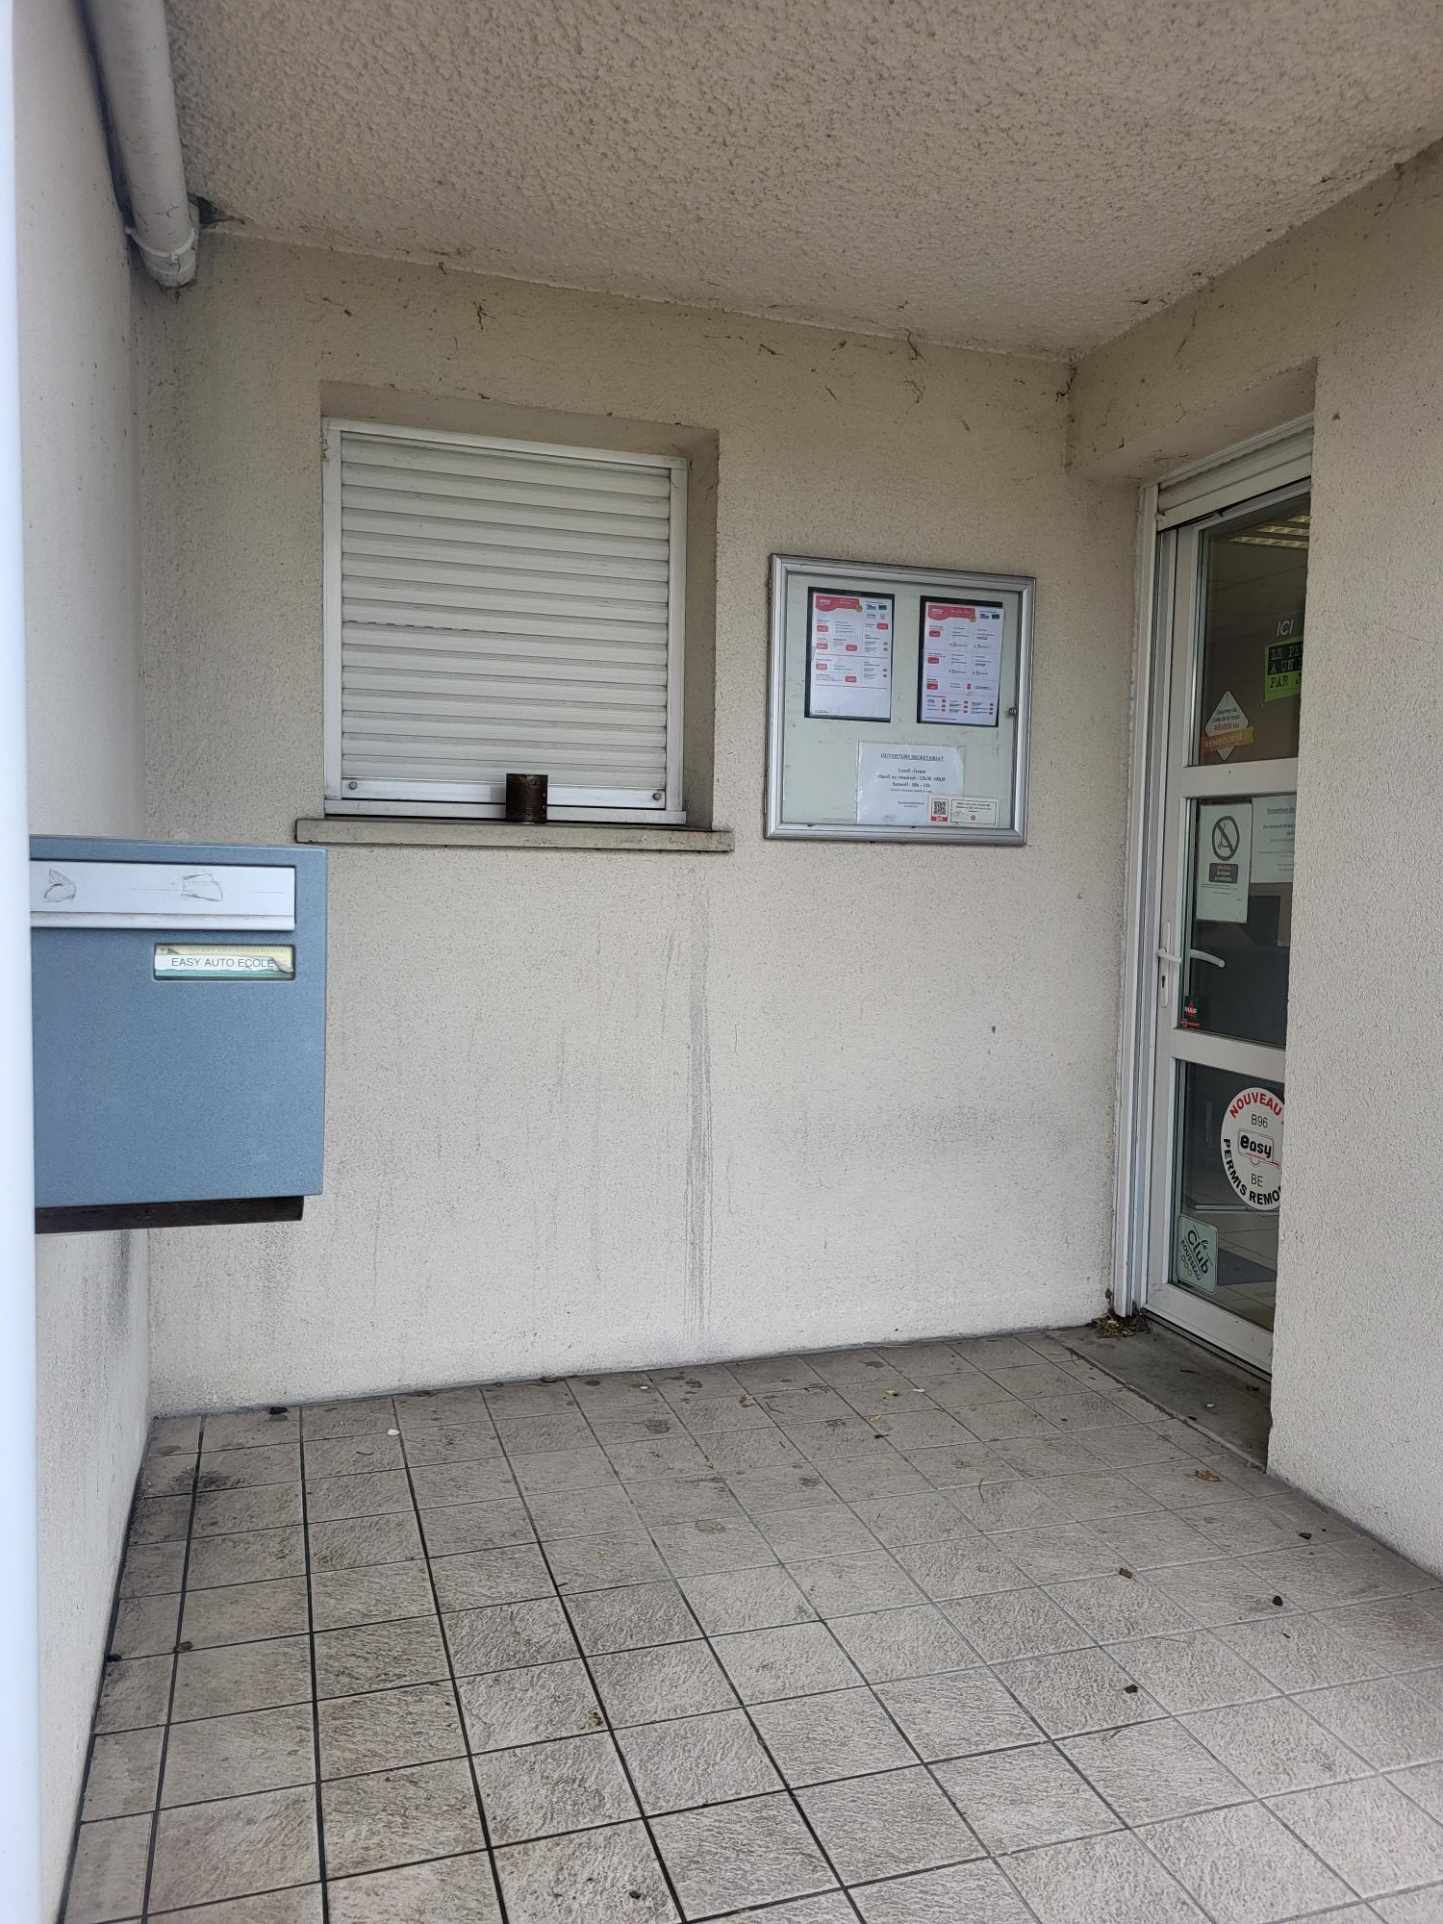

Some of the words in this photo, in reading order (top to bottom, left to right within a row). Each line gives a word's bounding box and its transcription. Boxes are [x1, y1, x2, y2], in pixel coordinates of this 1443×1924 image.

[1276, 619, 1294, 636] ICI
[1270, 648, 1283, 660] LE
[1281, 660, 1294, 672] UN
[1270, 674, 1289, 688] PAR
[171, 957, 201, 967] EASY
[204, 958, 235, 968] AUTO
[1229, 1092, 1282, 1119] NOUVEAU
[1251, 1113, 1268, 1128] B96
[1240, 1135, 1272, 1158] easy
[1223, 1138, 1247, 1196] PERMIS
[1249, 1185, 1281, 1205] REMO
[1251, 1173, 1264, 1187] BE
[1180, 1239, 1202, 1281] ROUSSEAU
